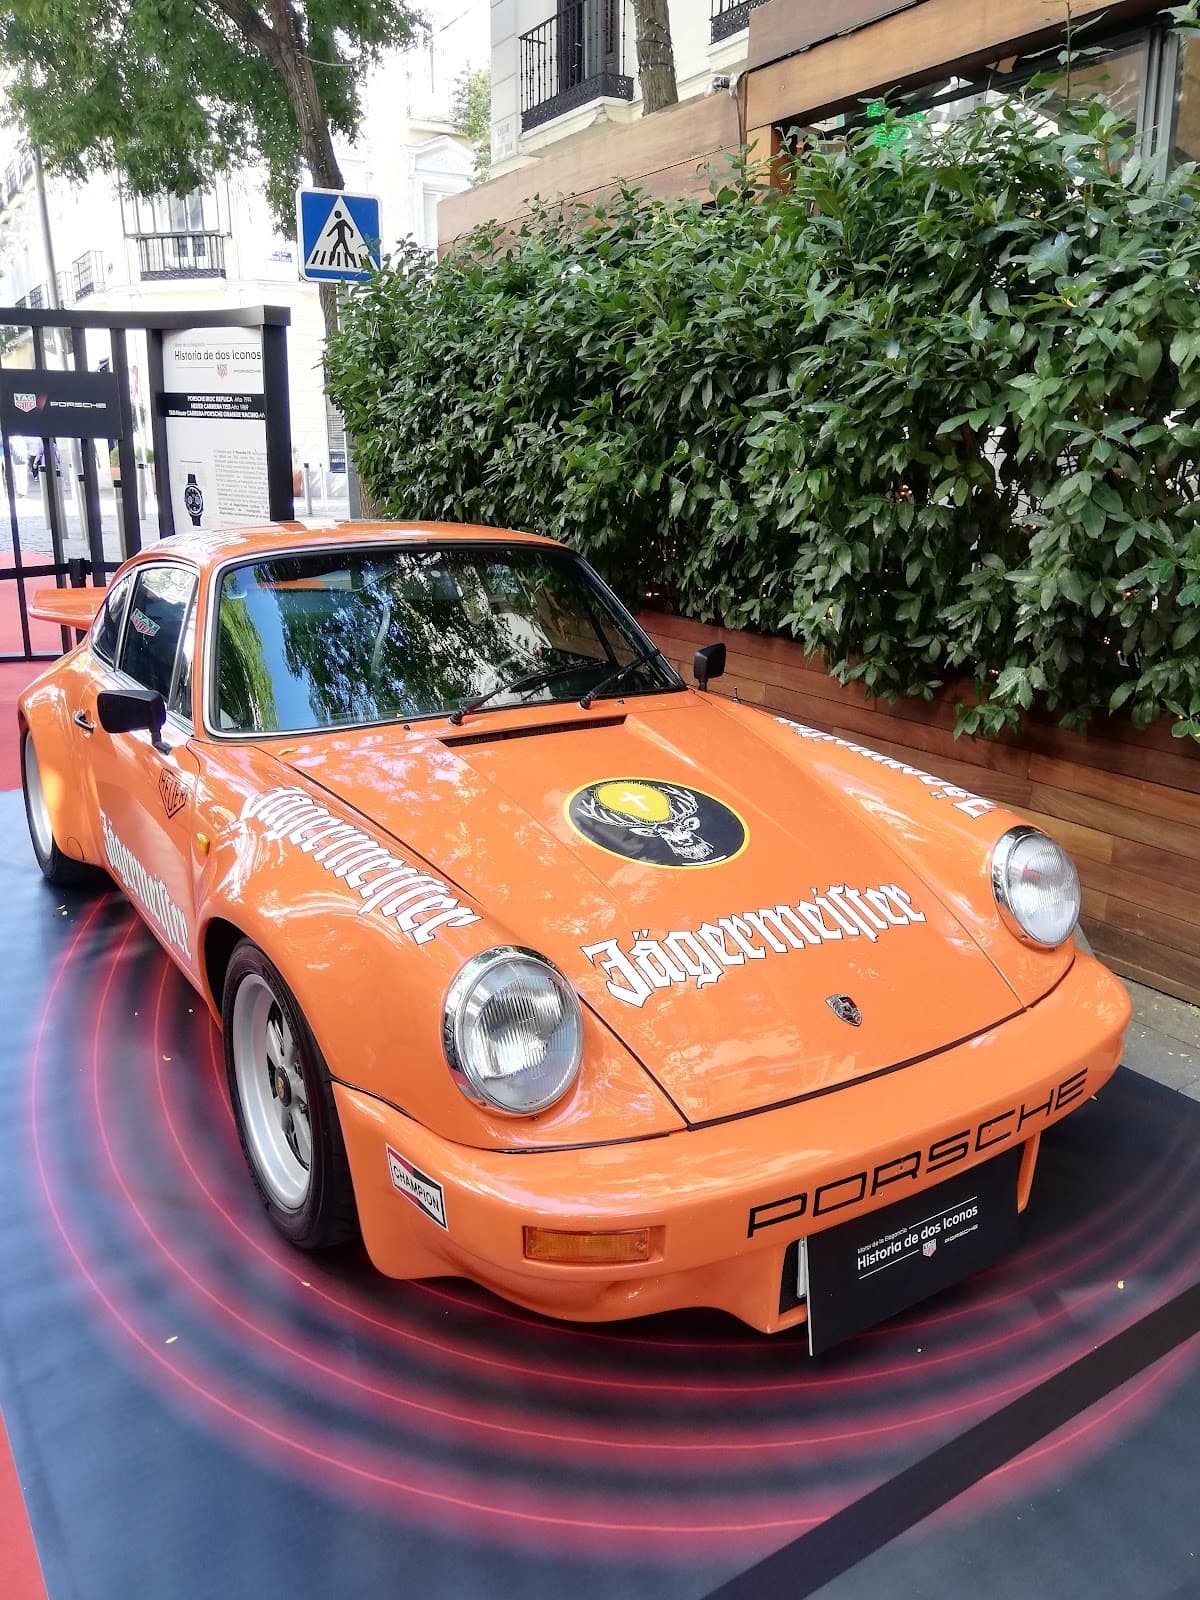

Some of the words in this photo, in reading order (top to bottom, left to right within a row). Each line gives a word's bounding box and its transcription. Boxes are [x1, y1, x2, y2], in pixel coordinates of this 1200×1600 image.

[174, 349, 202, 361] Historia
[203, 349, 214, 360] de
[215, 349, 231, 360] dos
[49, 401, 107, 409] PORSCHE
[580, 883, 927, 1008] Jägermeister
[747, 1068, 1089, 1239] PORSCHE
[393, 1165, 440, 1212] CHAMPION
[857, 1240, 902, 1271] Historia
[904, 1233, 919, 1248] de
[920, 1222, 941, 1240] dos
[942, 1205, 978, 1230] Iconos
